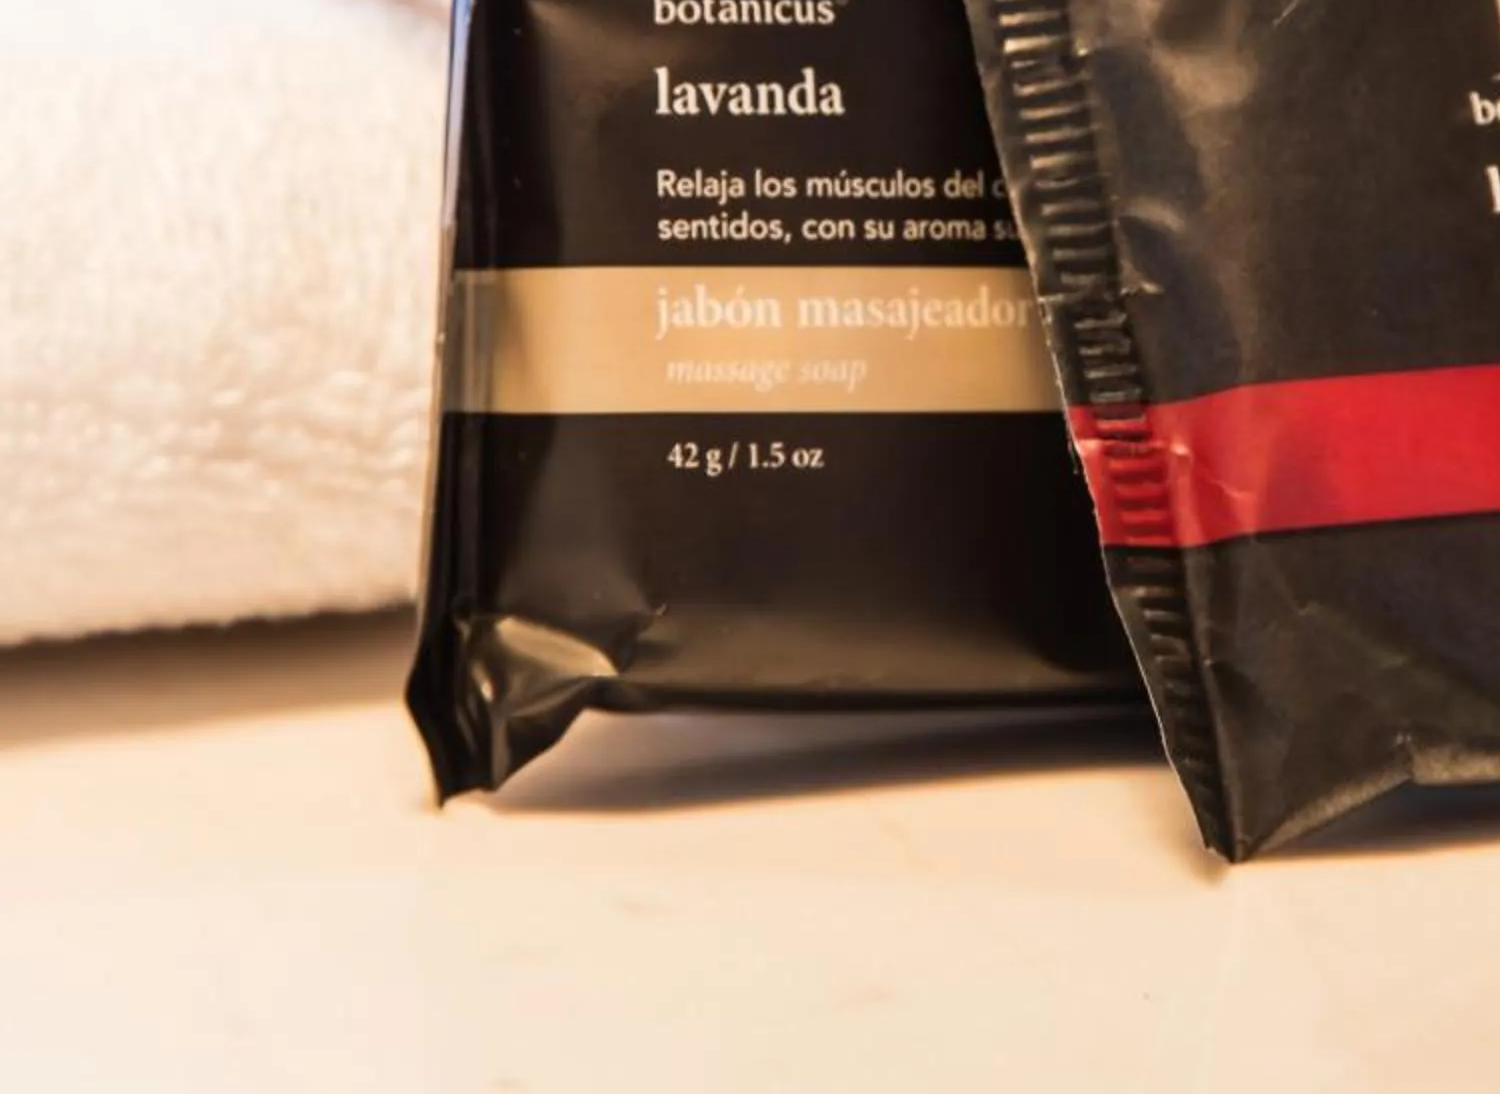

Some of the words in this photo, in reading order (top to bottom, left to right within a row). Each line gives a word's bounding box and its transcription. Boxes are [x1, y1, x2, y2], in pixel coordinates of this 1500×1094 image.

[655, 67, 846, 115] lavanda
[656, 169, 744, 205] Relaja
[755, 170, 797, 198] los
[806, 169, 935, 198] músculos
[944, 169, 984, 198] del
[657, 212, 791, 243] sentidos,
[802, 217, 854, 240] con
[864, 217, 894, 240] su
[903, 218, 986, 240] aroma
[655, 284, 782, 340] jabón
[797, 284, 1034, 340] masajeador
[667, 358, 790, 392] massage
[797, 358, 867, 392] soap
[667, 443, 699, 469] 42
[748, 443, 785, 469] 1.5
[792, 449, 825, 469] oz
